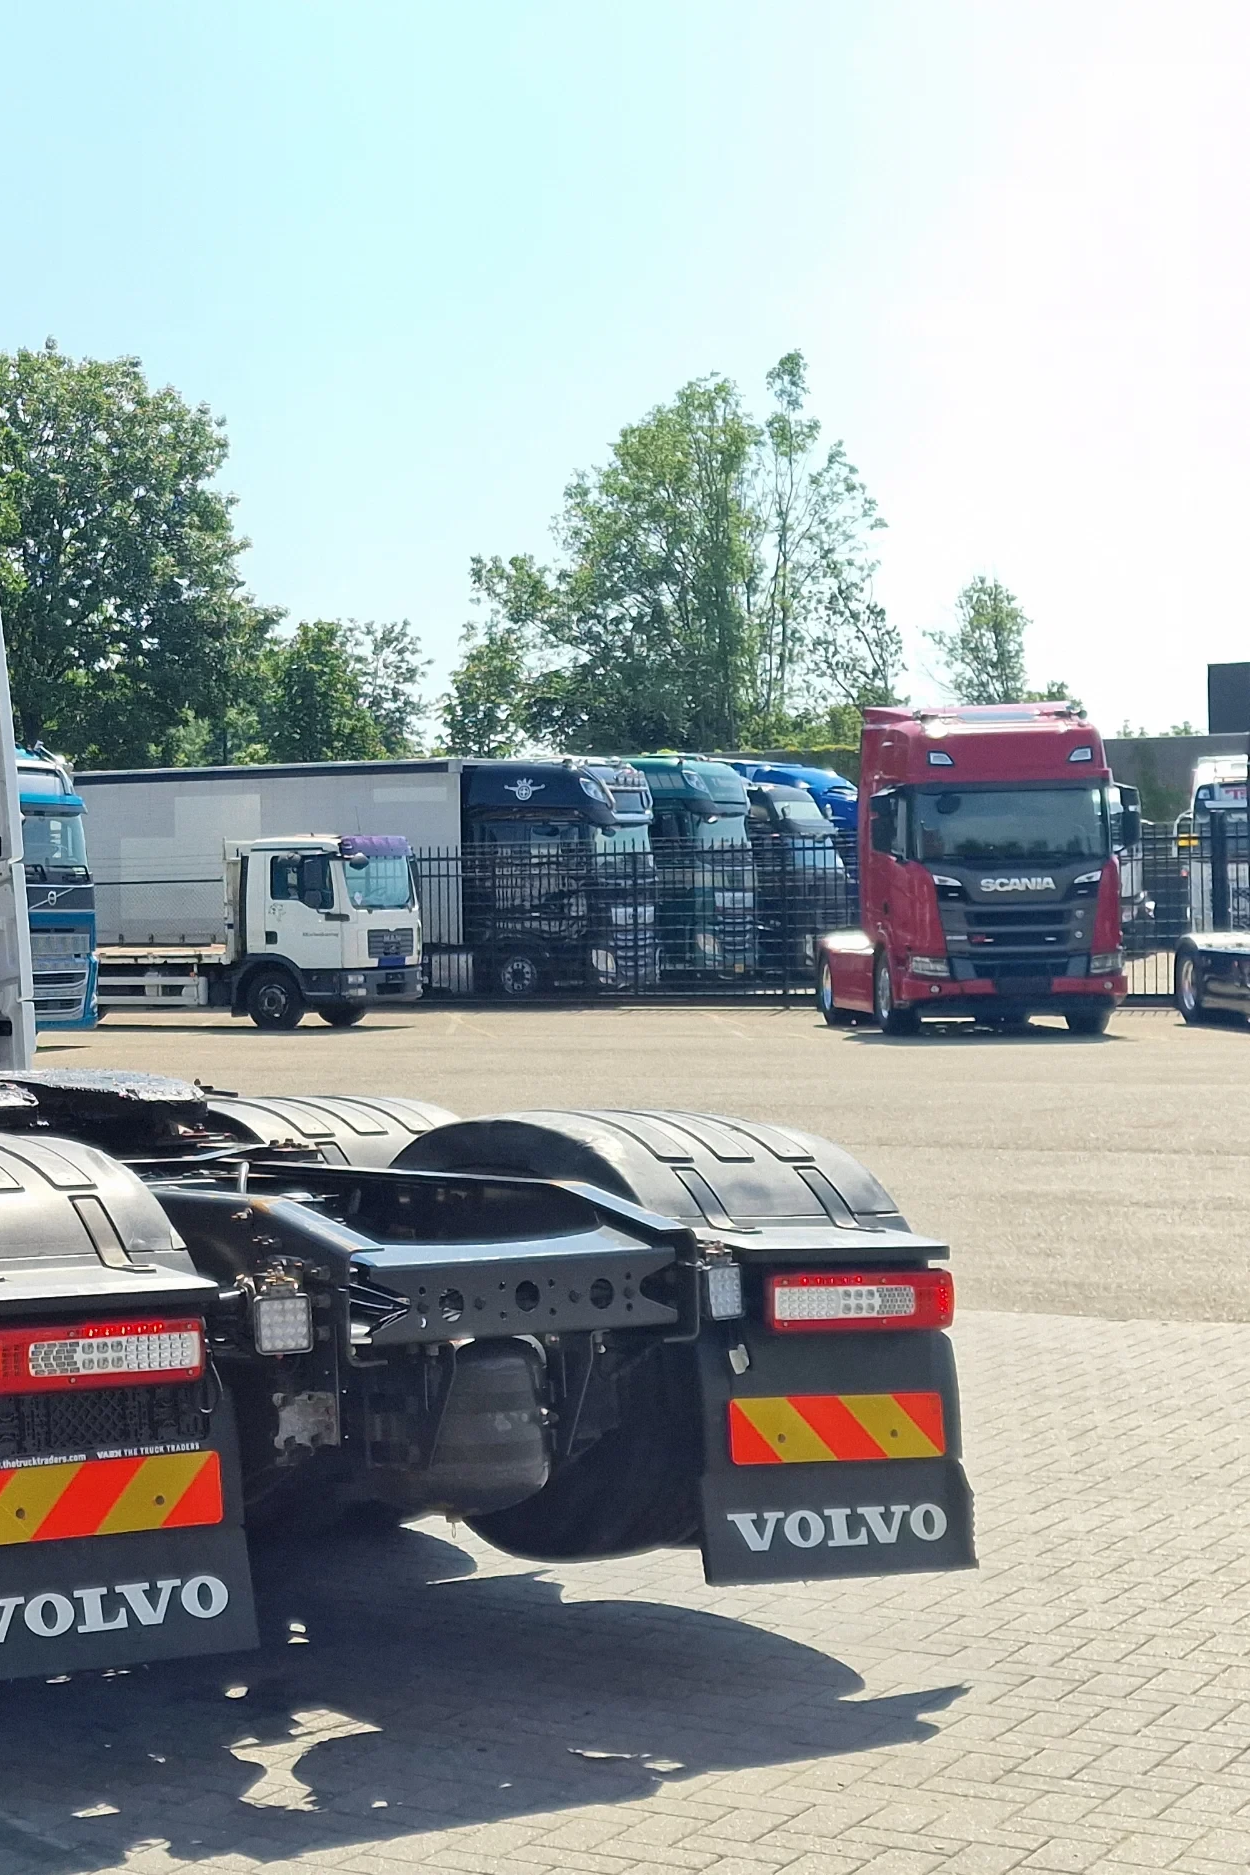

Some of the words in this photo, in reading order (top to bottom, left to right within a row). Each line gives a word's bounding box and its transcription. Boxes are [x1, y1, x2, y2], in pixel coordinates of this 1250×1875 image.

[980, 876, 1056, 892] SCANIA
[123, 1447, 138, 1457] THE
[139, 1444, 165, 1455] TRUCK
[166, 1441, 200, 1453] TRADERS
[723, 1503, 948, 1552] VOLVO
